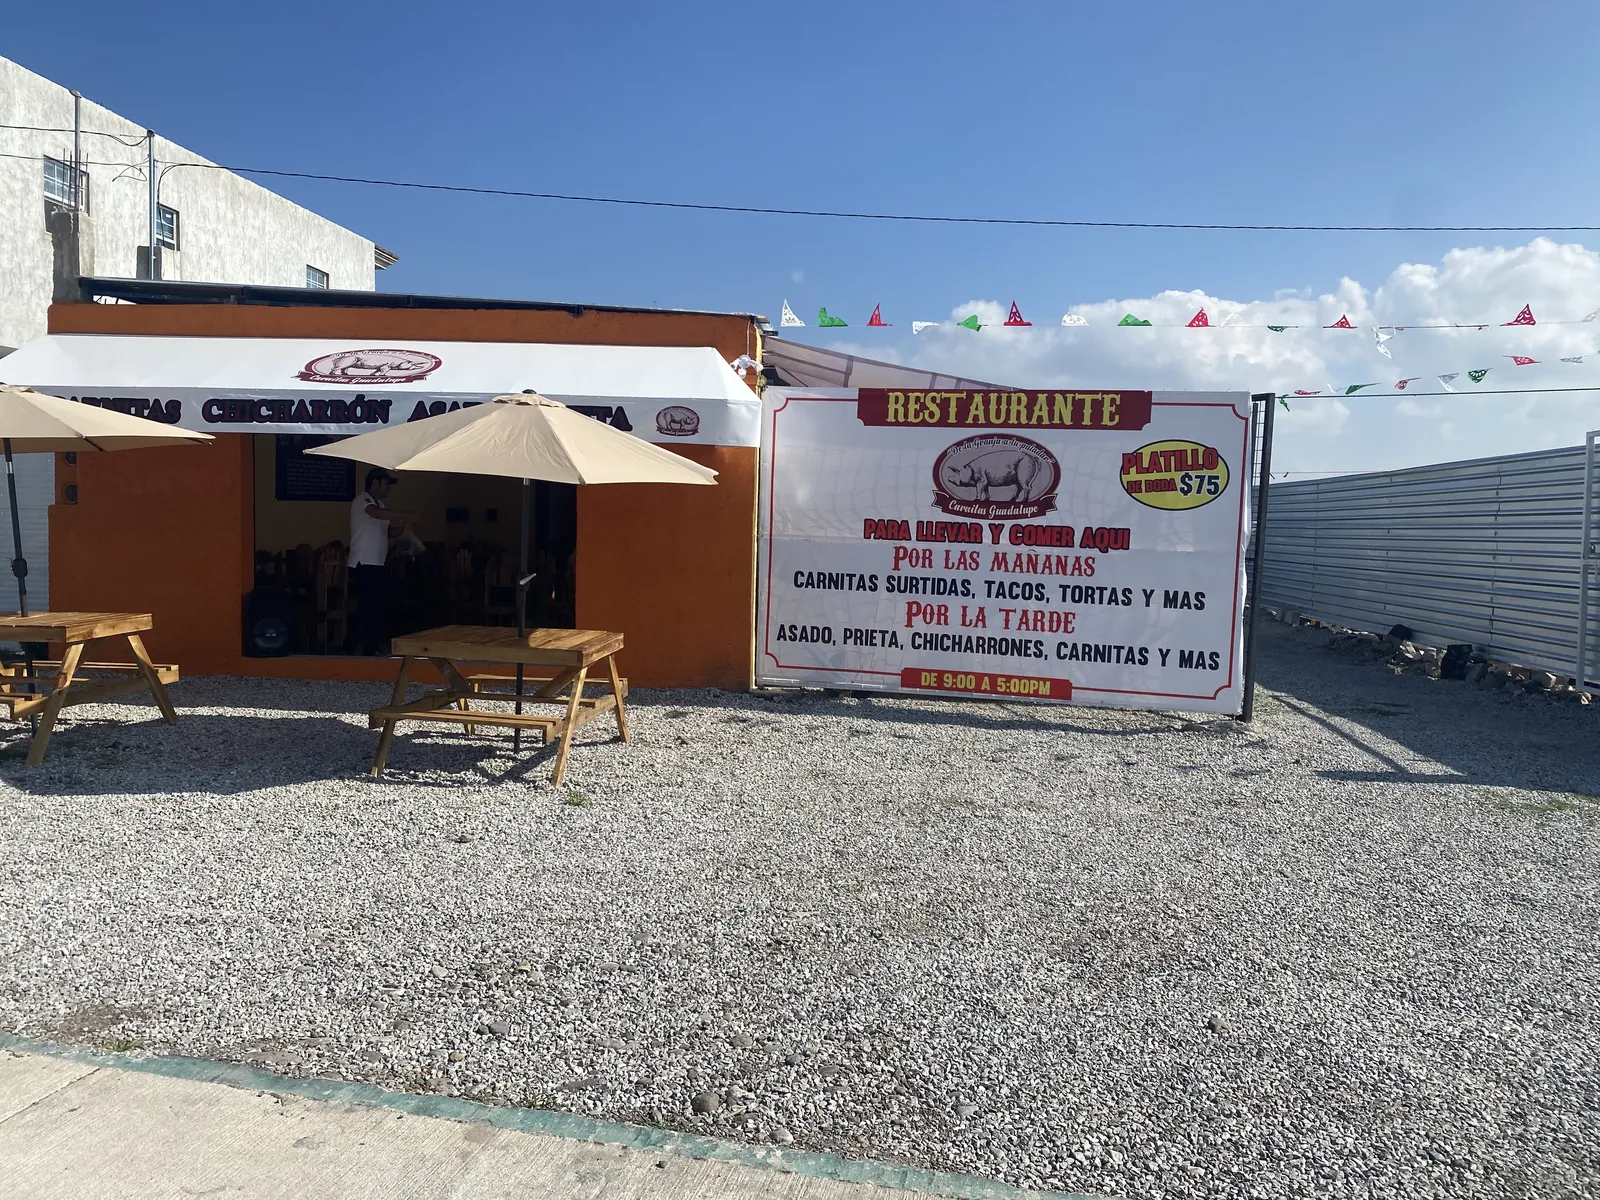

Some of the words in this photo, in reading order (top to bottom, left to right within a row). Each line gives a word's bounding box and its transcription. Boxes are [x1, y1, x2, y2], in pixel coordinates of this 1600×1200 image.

[202, 394, 393, 424] CHICHARRÓN
[886, 391, 1120, 426] RESTAURANTE
[972, 437, 1001, 449] Granja
[1122, 447, 1219, 475] PLATILLO
[1126, 480, 1142, 494] DE
[1144, 478, 1177, 493] BODA
[1179, 472, 1220, 496] $75
[949, 500, 987, 515] Carnitas
[989, 504, 1039, 519] Guadalupe
[863, 518, 912, 541] PARA
[915, 521, 983, 544] LLEVAR
[988, 523, 1005, 545] Y
[1009, 524, 1075, 548] COMER
[1079, 527, 1131, 553] AQUI
[943, 549, 980, 571] LAS
[793, 570, 879, 592] CARNITAS
[885, 575, 976, 599] SURTIDAS,
[984, 580, 1050, 603] TACOS,
[1059, 584, 1133, 606] TORTAS
[1142, 588, 1155, 607] Y
[1163, 589, 1206, 611] MAS
[961, 605, 987, 628] LA
[776, 623, 836, 646] ASADO,
[842, 628, 904, 650] PRIETA,
[911, 631, 1048, 661] CHICHARRONES,
[1056, 641, 1149, 666] CARNITAS
[1158, 648, 1171, 667] Y
[1178, 649, 1220, 671] MAS
[921, 671, 938, 687] DE
[943, 672, 975, 690] 9:00
[981, 676, 991, 691] A
[997, 677, 1051, 696] 5:00PM
